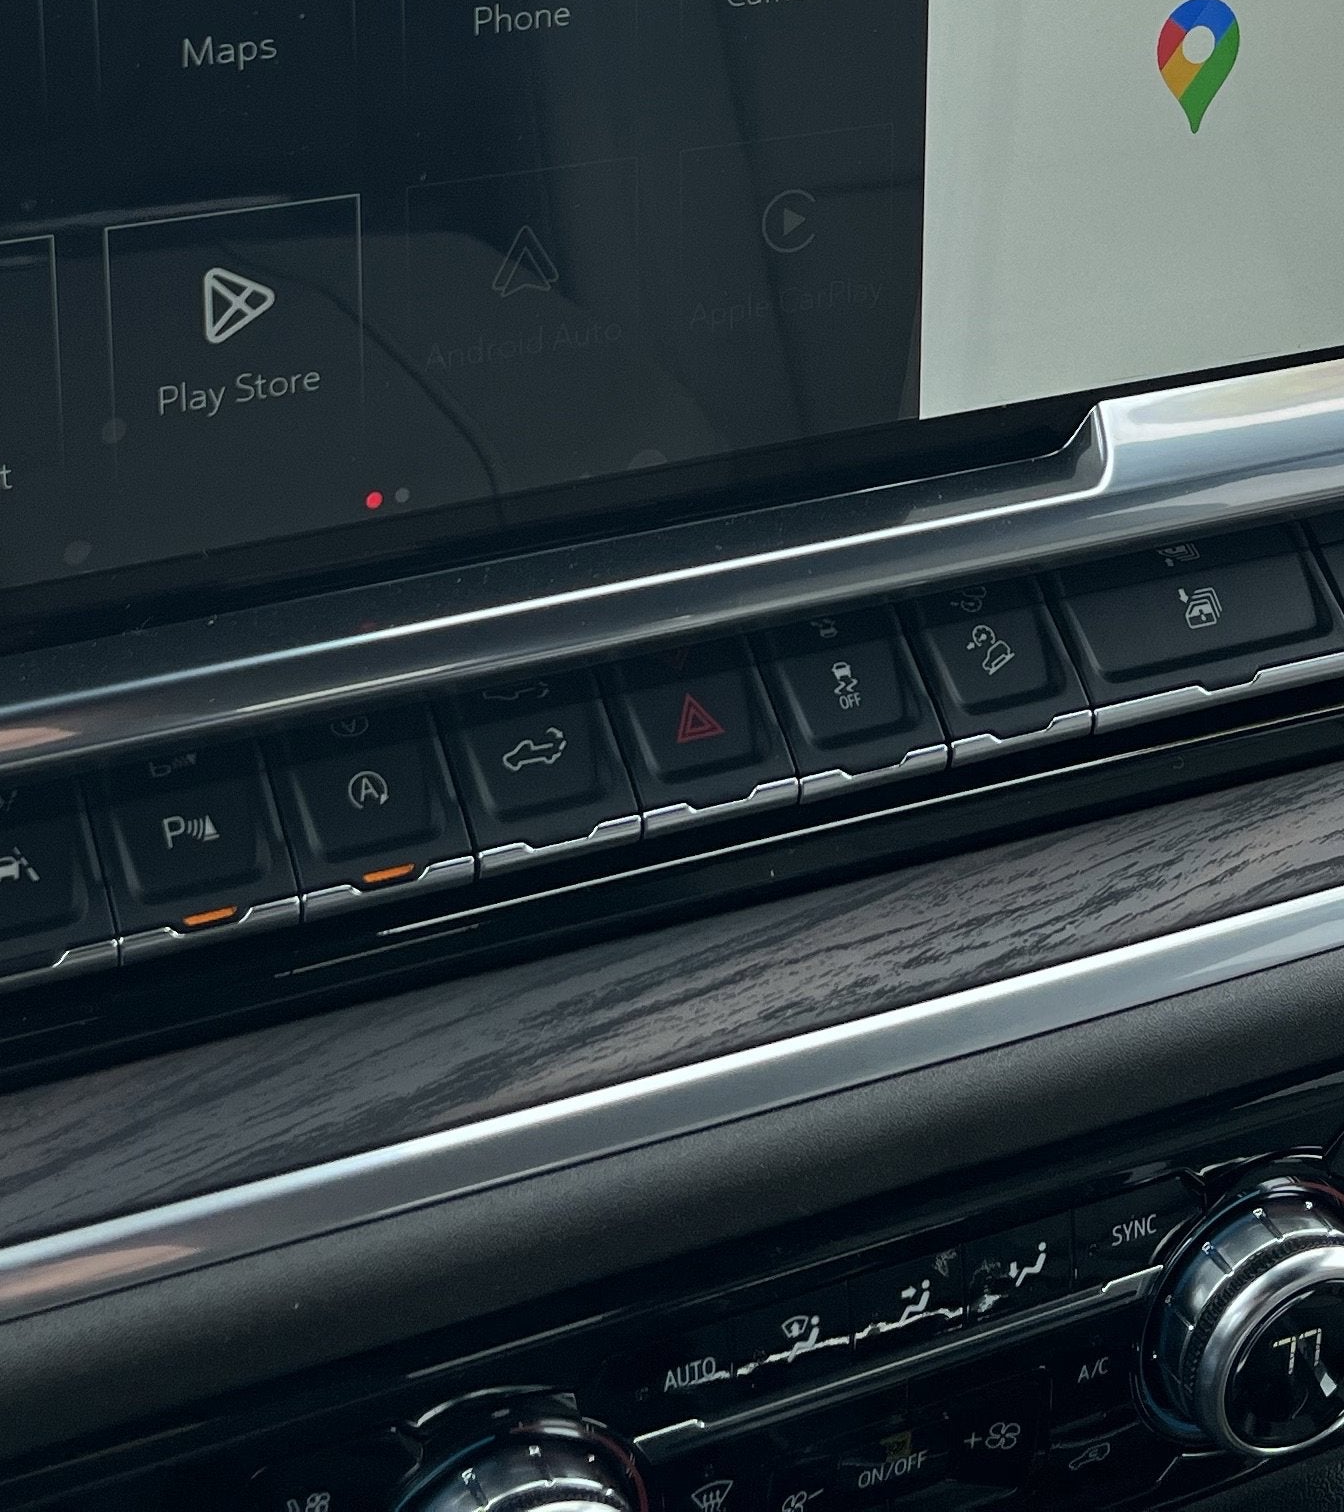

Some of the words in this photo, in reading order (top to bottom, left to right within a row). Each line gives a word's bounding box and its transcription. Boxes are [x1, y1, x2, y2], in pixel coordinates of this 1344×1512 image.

[475, 3, 571, 36] Phone
[183, 35, 277, 71] Maps
[159, 381, 226, 417] Play
[236, 371, 320, 402] Store
[839, 692, 861, 710] OFF
[1111, 1213, 1157, 1247] SYNC
[1272, 1327, 1322, 1375] 77
[663, 1356, 716, 1393] AUTO
[1077, 1356, 1109, 1383] A/C
[858, 1450, 928, 1489] ON/OFF
